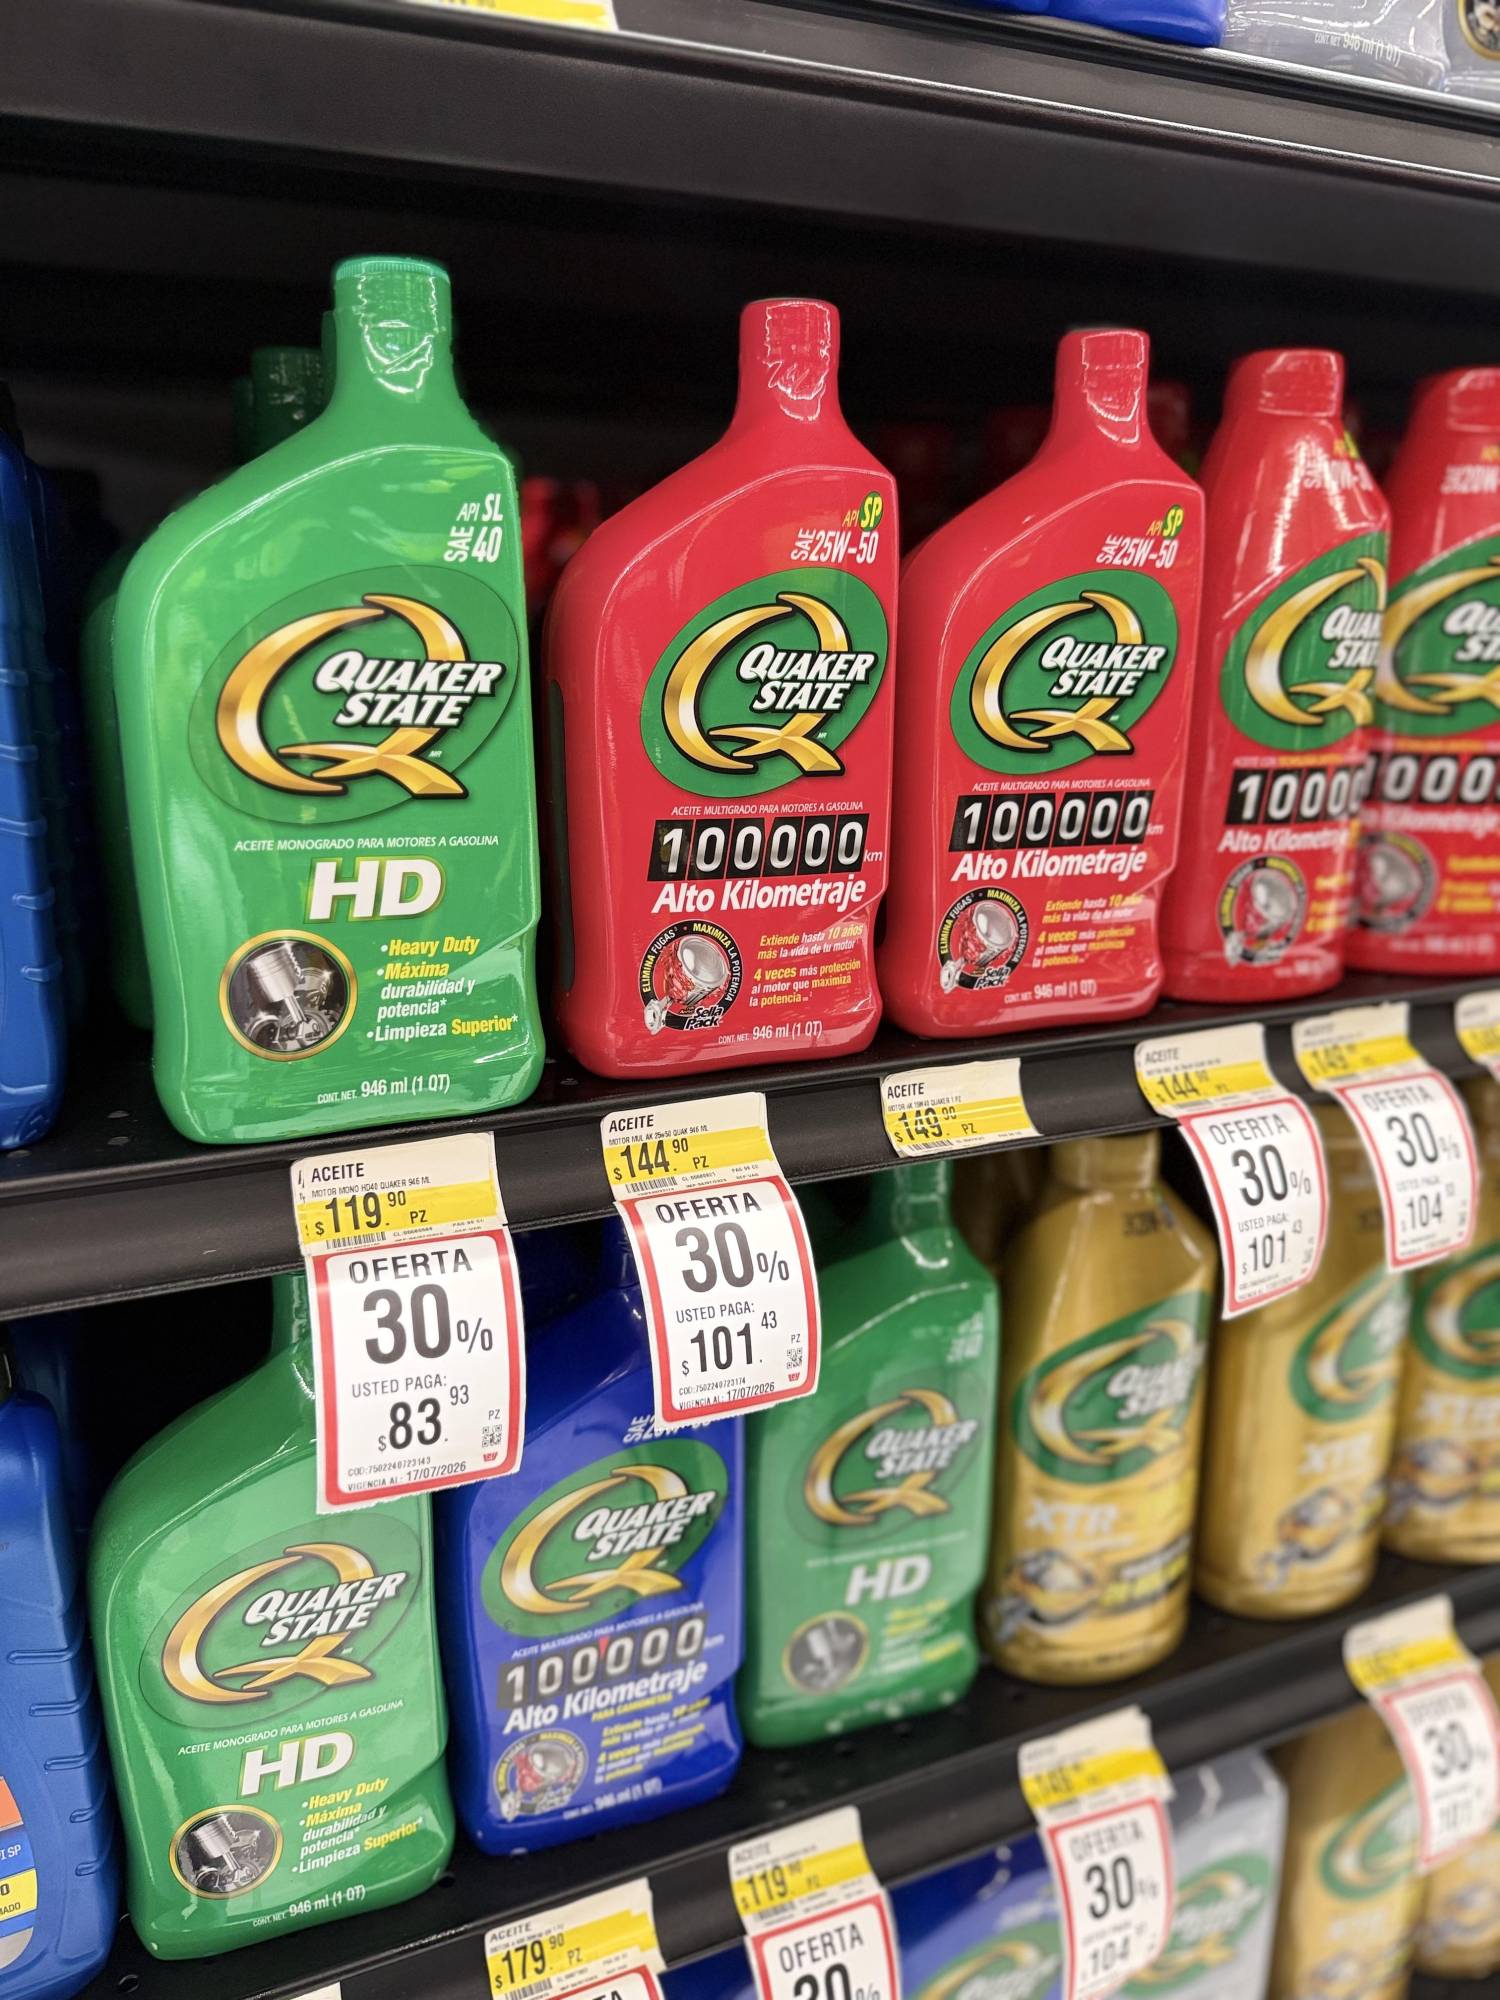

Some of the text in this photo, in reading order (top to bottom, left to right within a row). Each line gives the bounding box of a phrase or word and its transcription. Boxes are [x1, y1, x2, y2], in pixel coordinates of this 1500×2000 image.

[457, 493, 503, 521] API SL
[842, 496, 883, 528] API SP
[444, 526, 502, 562] SAE 40
[790, 528, 879, 564] SAE 25W-50
[1096, 535, 1180, 569] SAE 25W-50
[739, 644, 876, 681] QUAKER
[1040, 636, 1166, 671] QUAKER
[315, 650, 503, 693] QUAKER
[1050, 669, 1145, 696] STATE
[335, 692, 471, 726] STATE
[752, 681, 851, 711] STATE
[671, 801, 864, 816] ACEITE MULTIGRADO PARA MOTORES A GASOLINA
[963, 796, 1151, 845] 100000
[234, 835, 499, 852] ACEITE MONOGRADO PARA MOTORES A GASOLINA
[662, 821, 883, 874] 100000 km
[950, 845, 1148, 882] Alto Kilometraje
[307, 857, 444, 921] HD
[651, 873, 867, 914] Alto Kilometraje
[388, 936, 480, 957] Heavy Duty
[760, 933, 800, 947] Extiende
[801, 931, 825, 943] hasta
[827, 926, 841, 940] 10
[940, 918, 953, 954] ELIMINA
[384, 960, 449, 980] Máxima
[692, 922, 741, 1002] MAXIMIZA LA POTENCIA
[753, 959, 861, 981] 4 veces más protección
[380, 978, 476, 1000] durabilidad y
[751, 975, 852, 995] al motor que maximiza
[684, 1016, 719, 1031] Pack
[693, 1005, 723, 1019] Sella
[374, 1020, 447, 1043] Limpieza
[752, 1025, 773, 1040] 946
[775, 1023, 789, 1037] ml
[361, 1078, 388, 1098] 946
[390, 1077, 408, 1095] ml
[887, 1082, 925, 1099] ACEITE
[609, 1114, 655, 1133] ACEITE
[961, 1122, 977, 1136] PZ
[1209, 1113, 1292, 1145] OFERTA
[311, 1162, 365, 1182] ACEITE
[692, 1155, 710, 1170] PZ
[311, 1187, 337, 1199] MOTOR
[338, 1184, 359, 1195] MONO
[380, 1178, 407, 1191] QUAKER
[409, 1209, 428, 1224] PZ
[655, 1191, 762, 1224] OFERTA
[349, 1248, 473, 1284] OFERTA
[676, 1300, 755, 1324] USTED PAGA:
[790, 1333, 801, 1343] PZ
[351, 1373, 448, 1399] USTED PAGA:
[727, 1382, 775, 1400] 17/07/2026
[488, 1408, 501, 1420] PZ
[865, 1418, 978, 1461] QUAKER
[406, 1461, 467, 1482] 17/07/2026
[875, 1446, 953, 1479] STATE
[574, 1490, 717, 1541] QUAKER
[587, 1516, 692, 1561] STATE
[845, 1553, 931, 1605] HD
[244, 1572, 407, 1625] QUAKER
[260, 1600, 379, 1647] STATE
[503, 1661, 709, 1735] Alto Kilometraje
[177, 1699, 404, 1756] ACEITE MONOGRADO PARA MOTORES A GASOLINA
[240, 1730, 354, 1797] HD
[308, 1777, 389, 1810] Heavy Duty
[7, 1844, 22, 1858] SP
[299, 1844, 362, 1874] Limpieza
[490, 1922, 533, 1942] ACEITE
[567, 1947, 583, 1966] PZ
[779, 1922, 864, 1974] OFERTA
